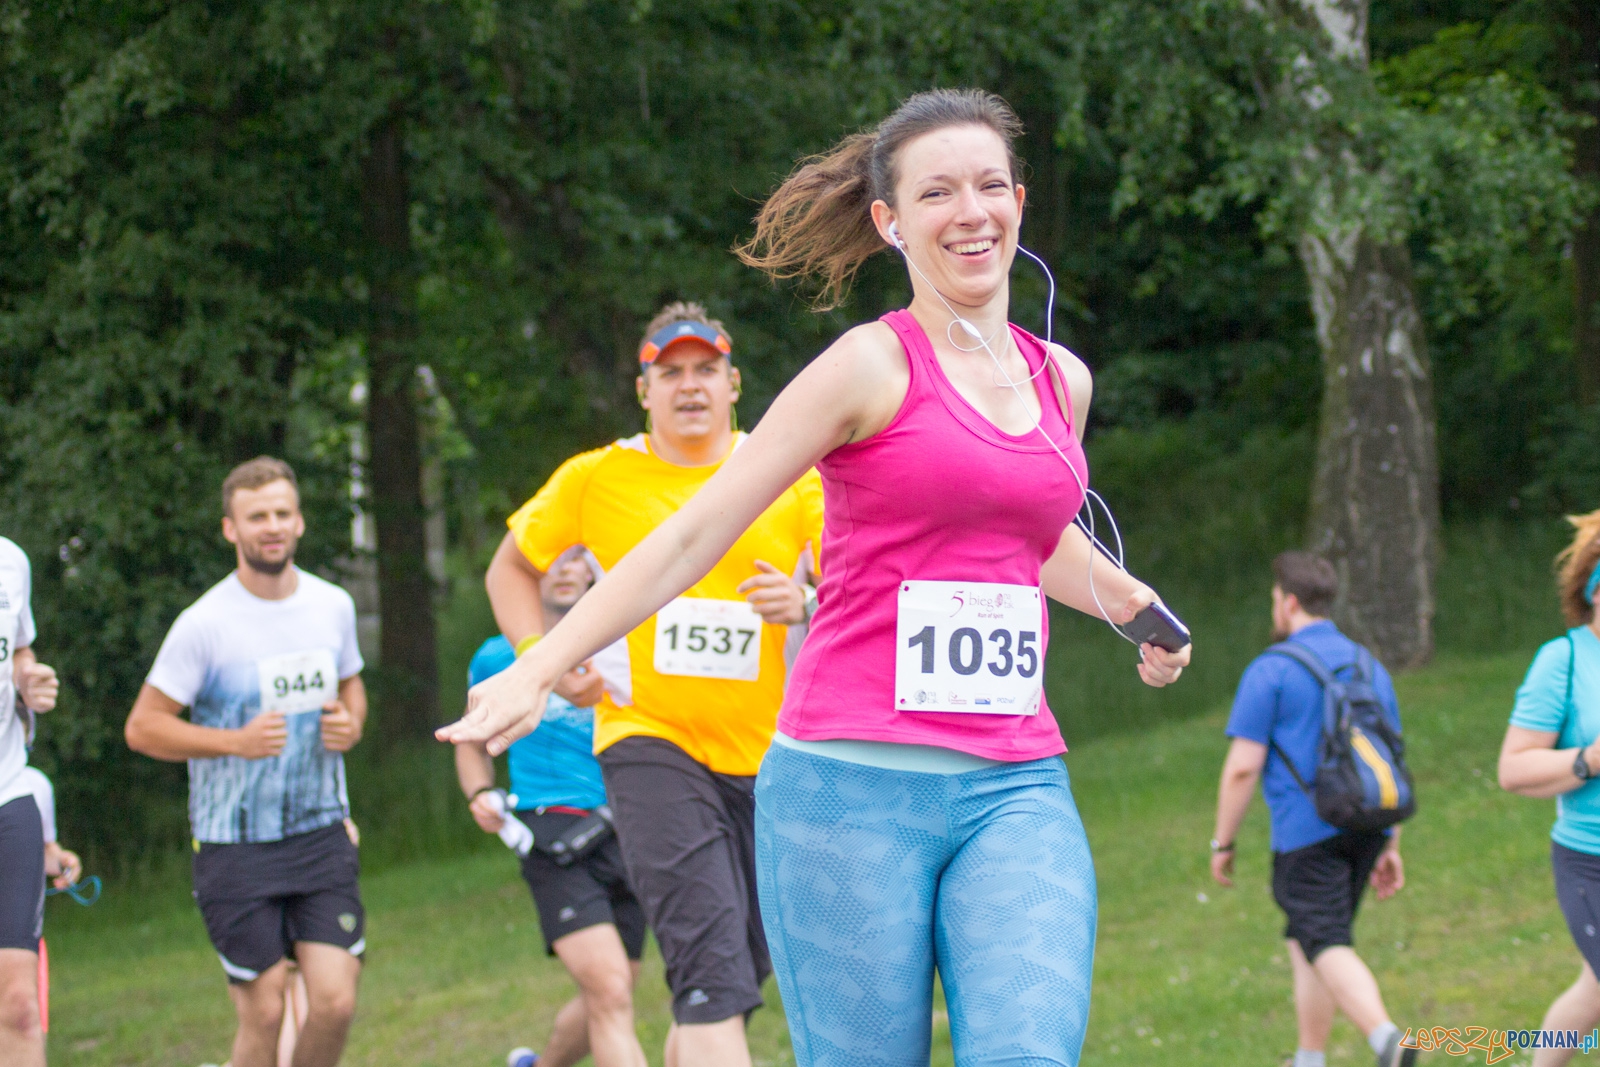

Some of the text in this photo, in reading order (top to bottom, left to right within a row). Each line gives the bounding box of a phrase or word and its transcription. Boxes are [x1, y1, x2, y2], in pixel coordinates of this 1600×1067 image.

[949, 590, 994, 618] 5 bieg
[664, 624, 756, 656] 1537
[908, 625, 1038, 678] 1035
[273, 669, 325, 698] 944
